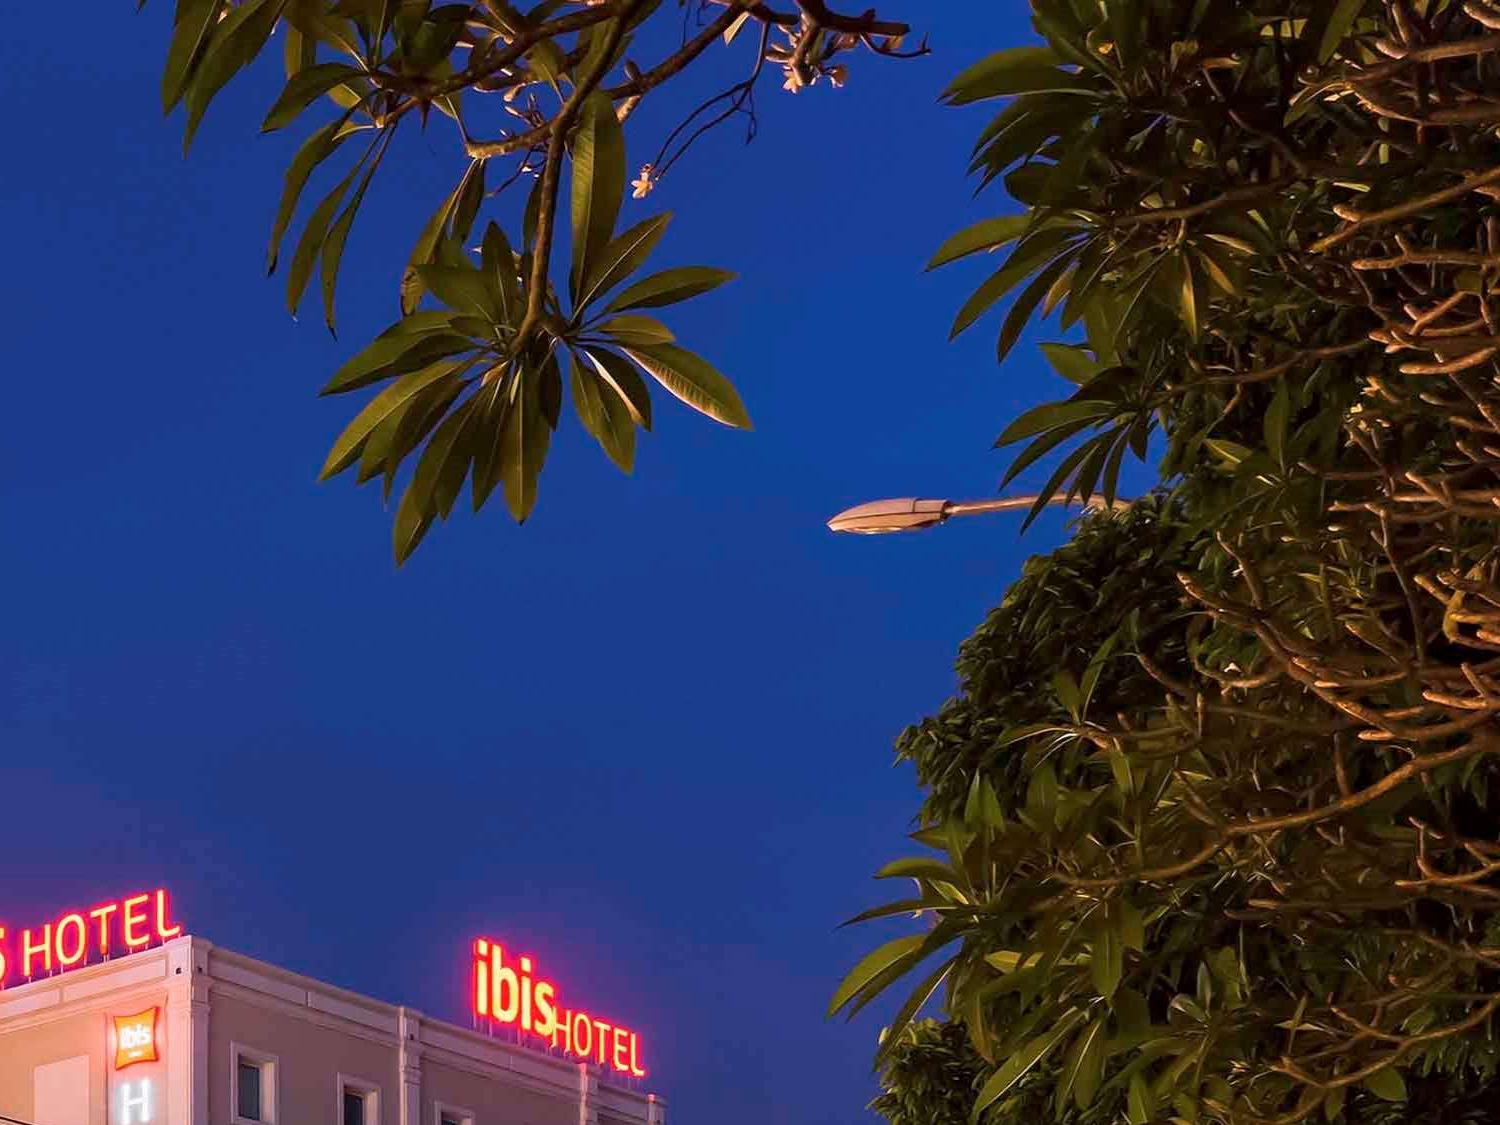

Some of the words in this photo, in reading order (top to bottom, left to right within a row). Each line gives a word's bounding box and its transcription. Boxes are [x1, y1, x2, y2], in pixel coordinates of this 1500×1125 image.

[21, 889, 181, 977] HOTEL
[477, 938, 554, 1037] ibis
[551, 1005, 645, 1077] HOTEL
